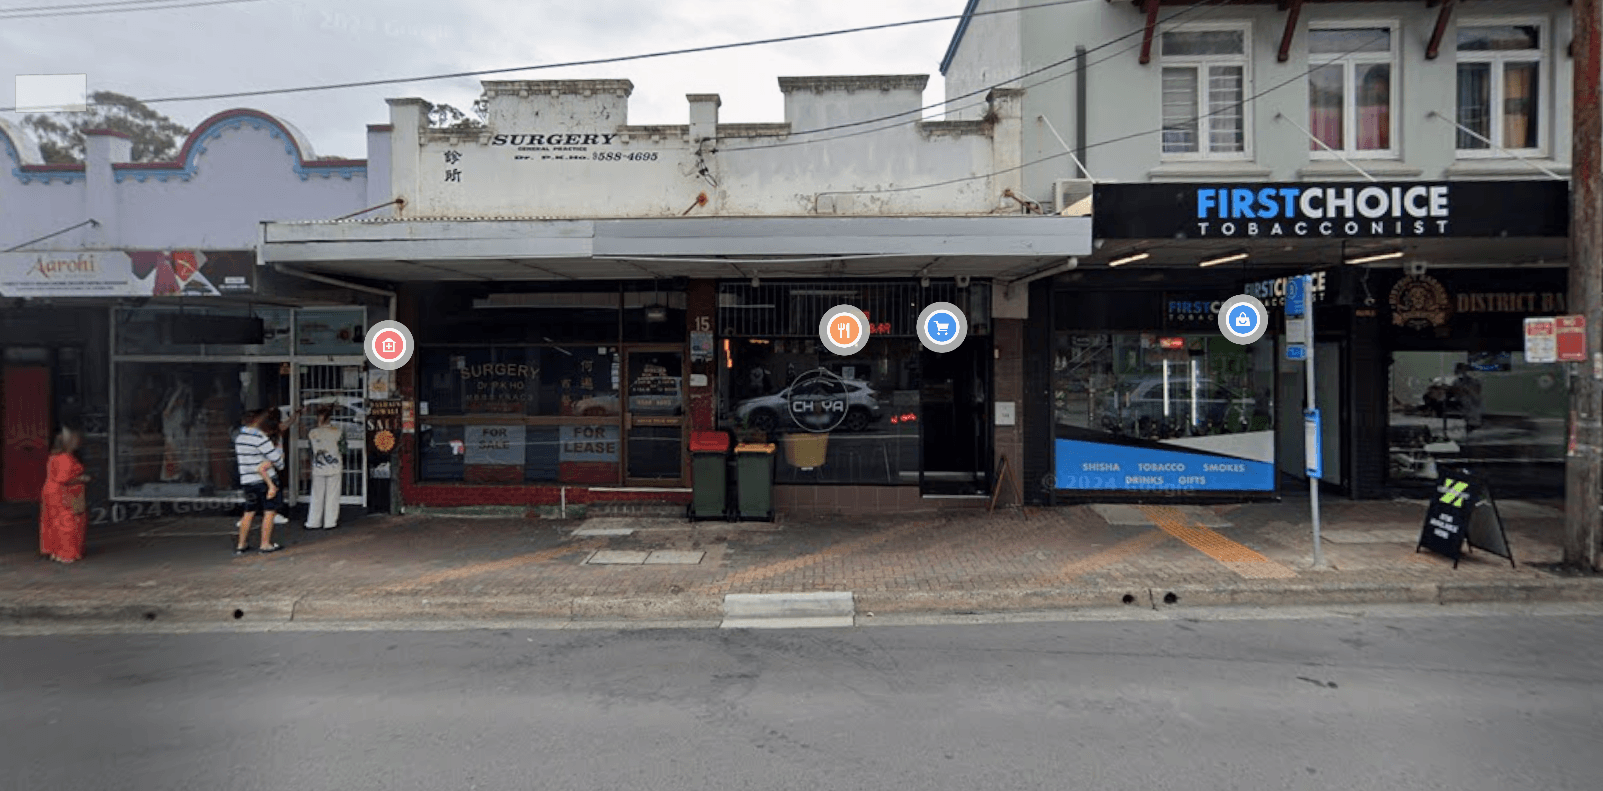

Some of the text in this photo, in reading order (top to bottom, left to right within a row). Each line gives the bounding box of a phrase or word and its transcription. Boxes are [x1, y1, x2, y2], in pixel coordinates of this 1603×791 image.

[492, 133, 617, 146] SURGERY
[1197, 186, 1449, 219] FIRSTCHOICE
[1198, 220, 1448, 236] TOBACCONIST
[1457, 293, 1536, 312] DISTRICT
[694, 315, 711, 332] 15
[460, 363, 541, 379] SURGERY
[482, 428, 507, 438] FOR
[574, 427, 606, 438] FOR
[479, 440, 510, 450] SALE
[563, 442, 616, 454] LEASE
[1082, 462, 1246, 473] SHISHA TOBACCO SMOKES
[1125, 475, 1205, 485] DRINKS GIFTS
